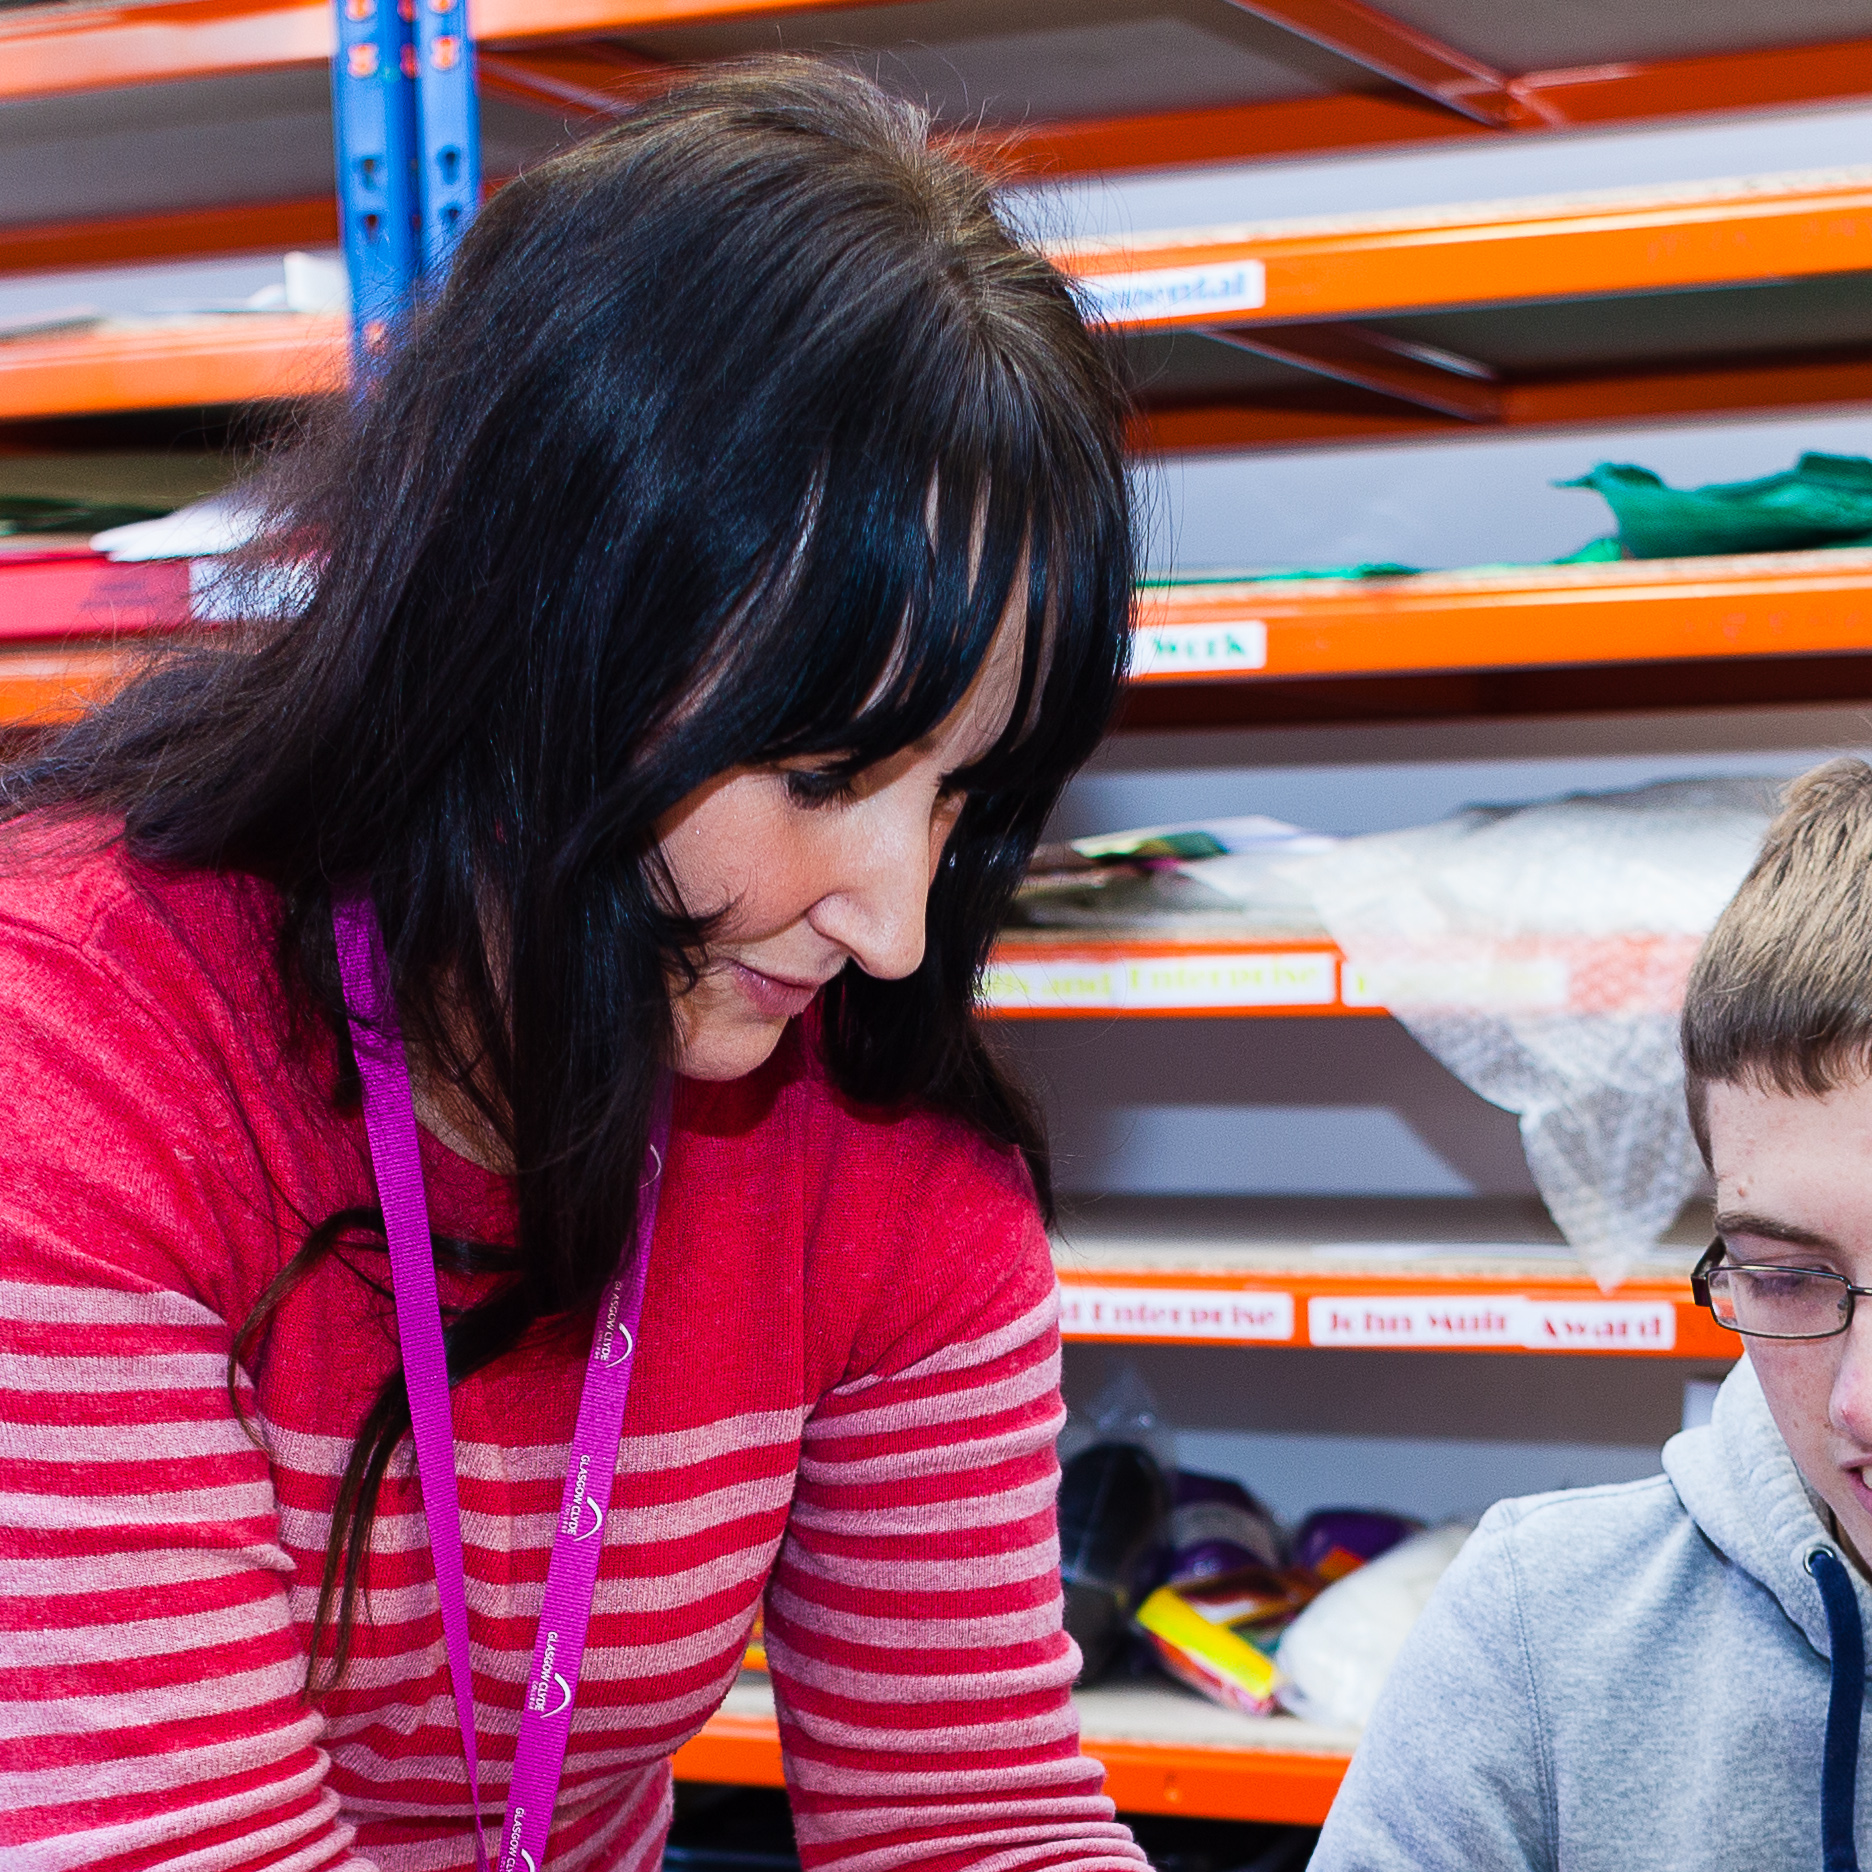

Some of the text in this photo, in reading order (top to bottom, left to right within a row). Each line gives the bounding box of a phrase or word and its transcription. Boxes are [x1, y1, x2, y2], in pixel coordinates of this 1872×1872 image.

[600, 1281, 623, 1361] GLASGOW CLYDE
[1092, 1302, 1277, 1326] Enterprise
[1330, 1311, 1413, 1333] John
[1544, 1315, 1662, 1339] Award
[566, 1454, 590, 1536] GLASGOW CLYDE
[534, 1631, 558, 1712] GLASGOW CLYDE
[508, 1806, 525, 1857] GLASGOW
